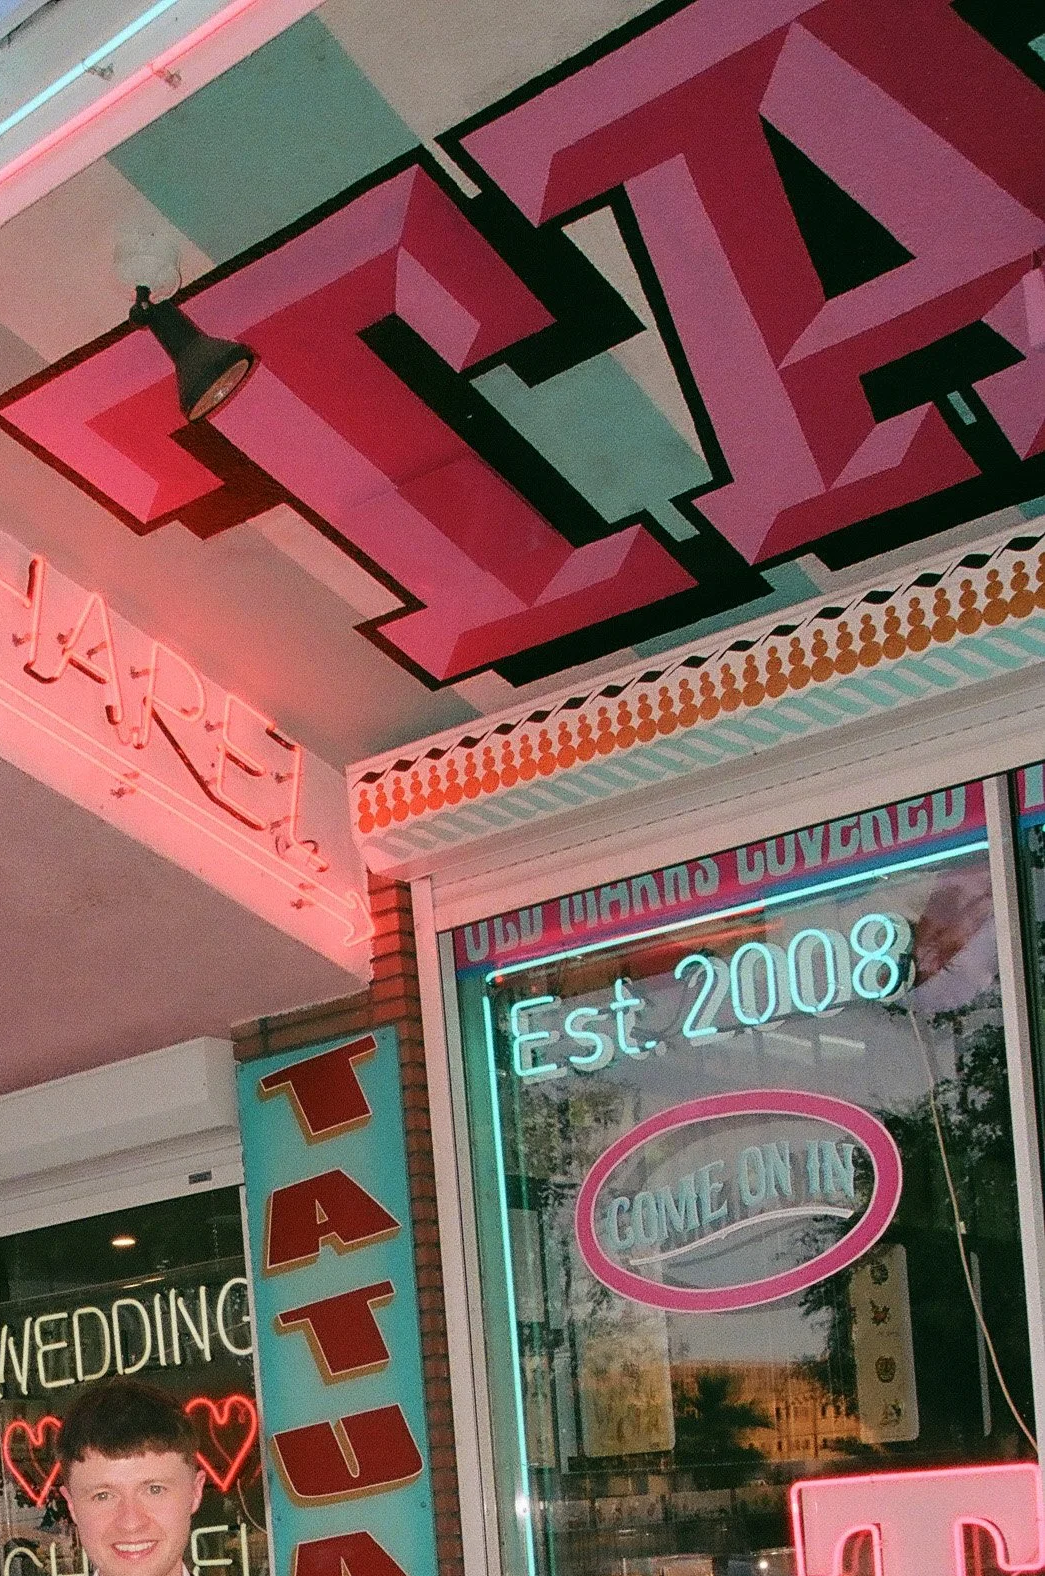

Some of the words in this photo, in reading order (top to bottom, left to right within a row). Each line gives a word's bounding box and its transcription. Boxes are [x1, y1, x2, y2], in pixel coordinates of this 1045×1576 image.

[511, 978, 659, 1080] Est.
[674, 912, 908, 1040] 2008
[605, 1160, 728, 1251] COME
[736, 1140, 793, 1207] ON
[805, 1140, 855, 1198] IN
